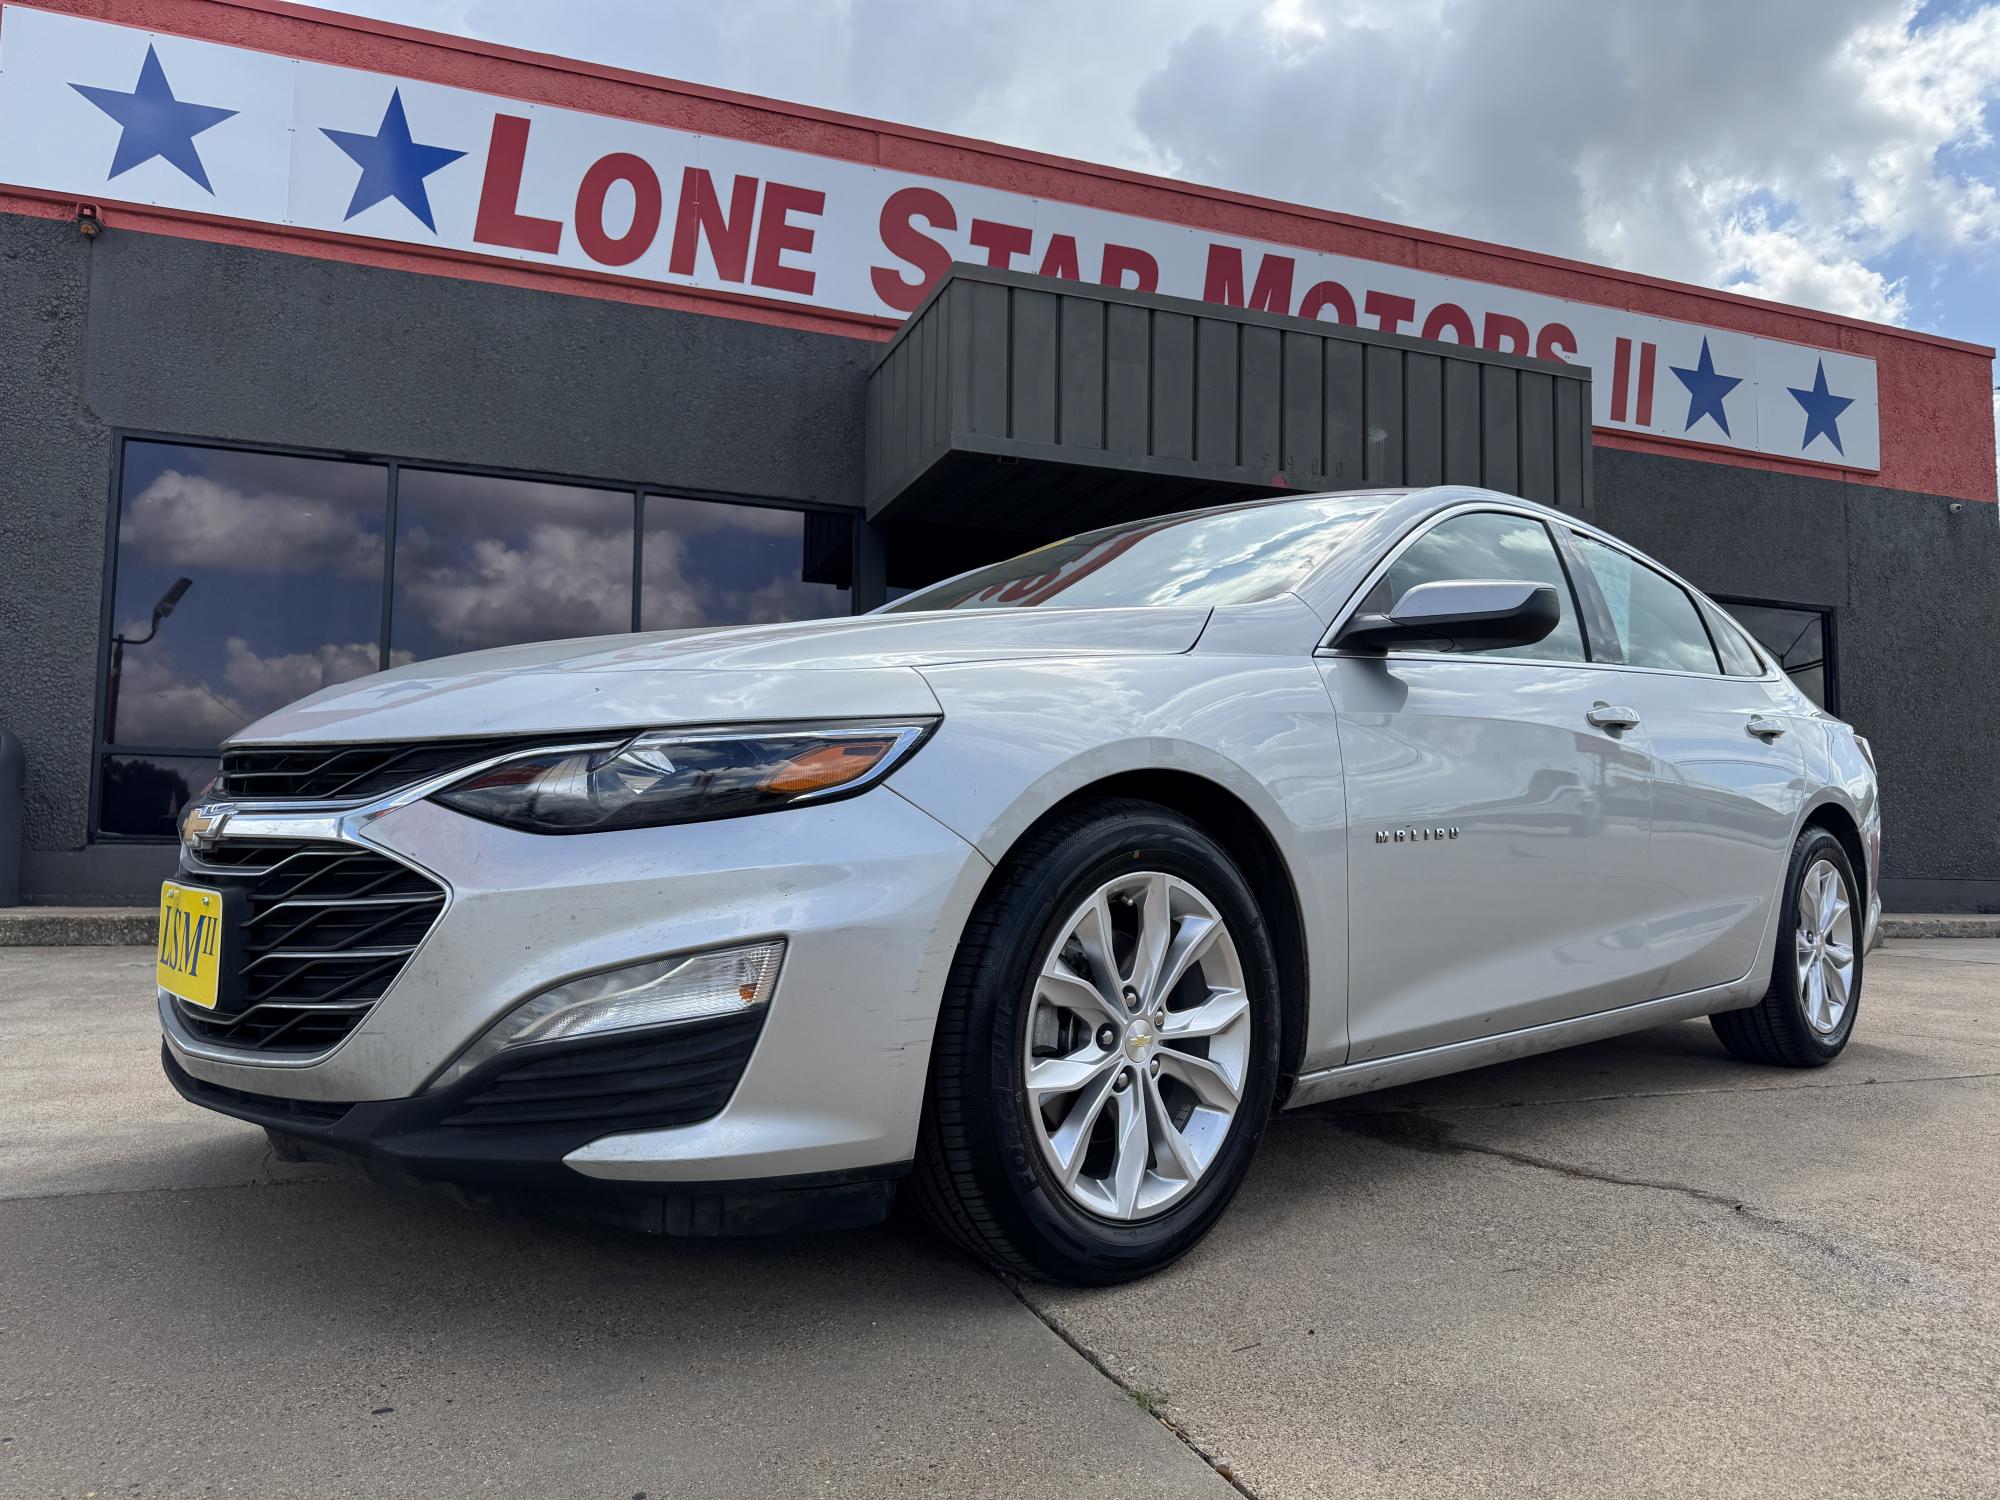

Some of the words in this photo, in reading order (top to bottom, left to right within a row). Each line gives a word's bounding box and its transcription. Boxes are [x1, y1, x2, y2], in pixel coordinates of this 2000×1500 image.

[474, 113, 826, 296] LONE
[1610, 337, 1657, 427] II
[1375, 827, 1460, 844] MALIBU
